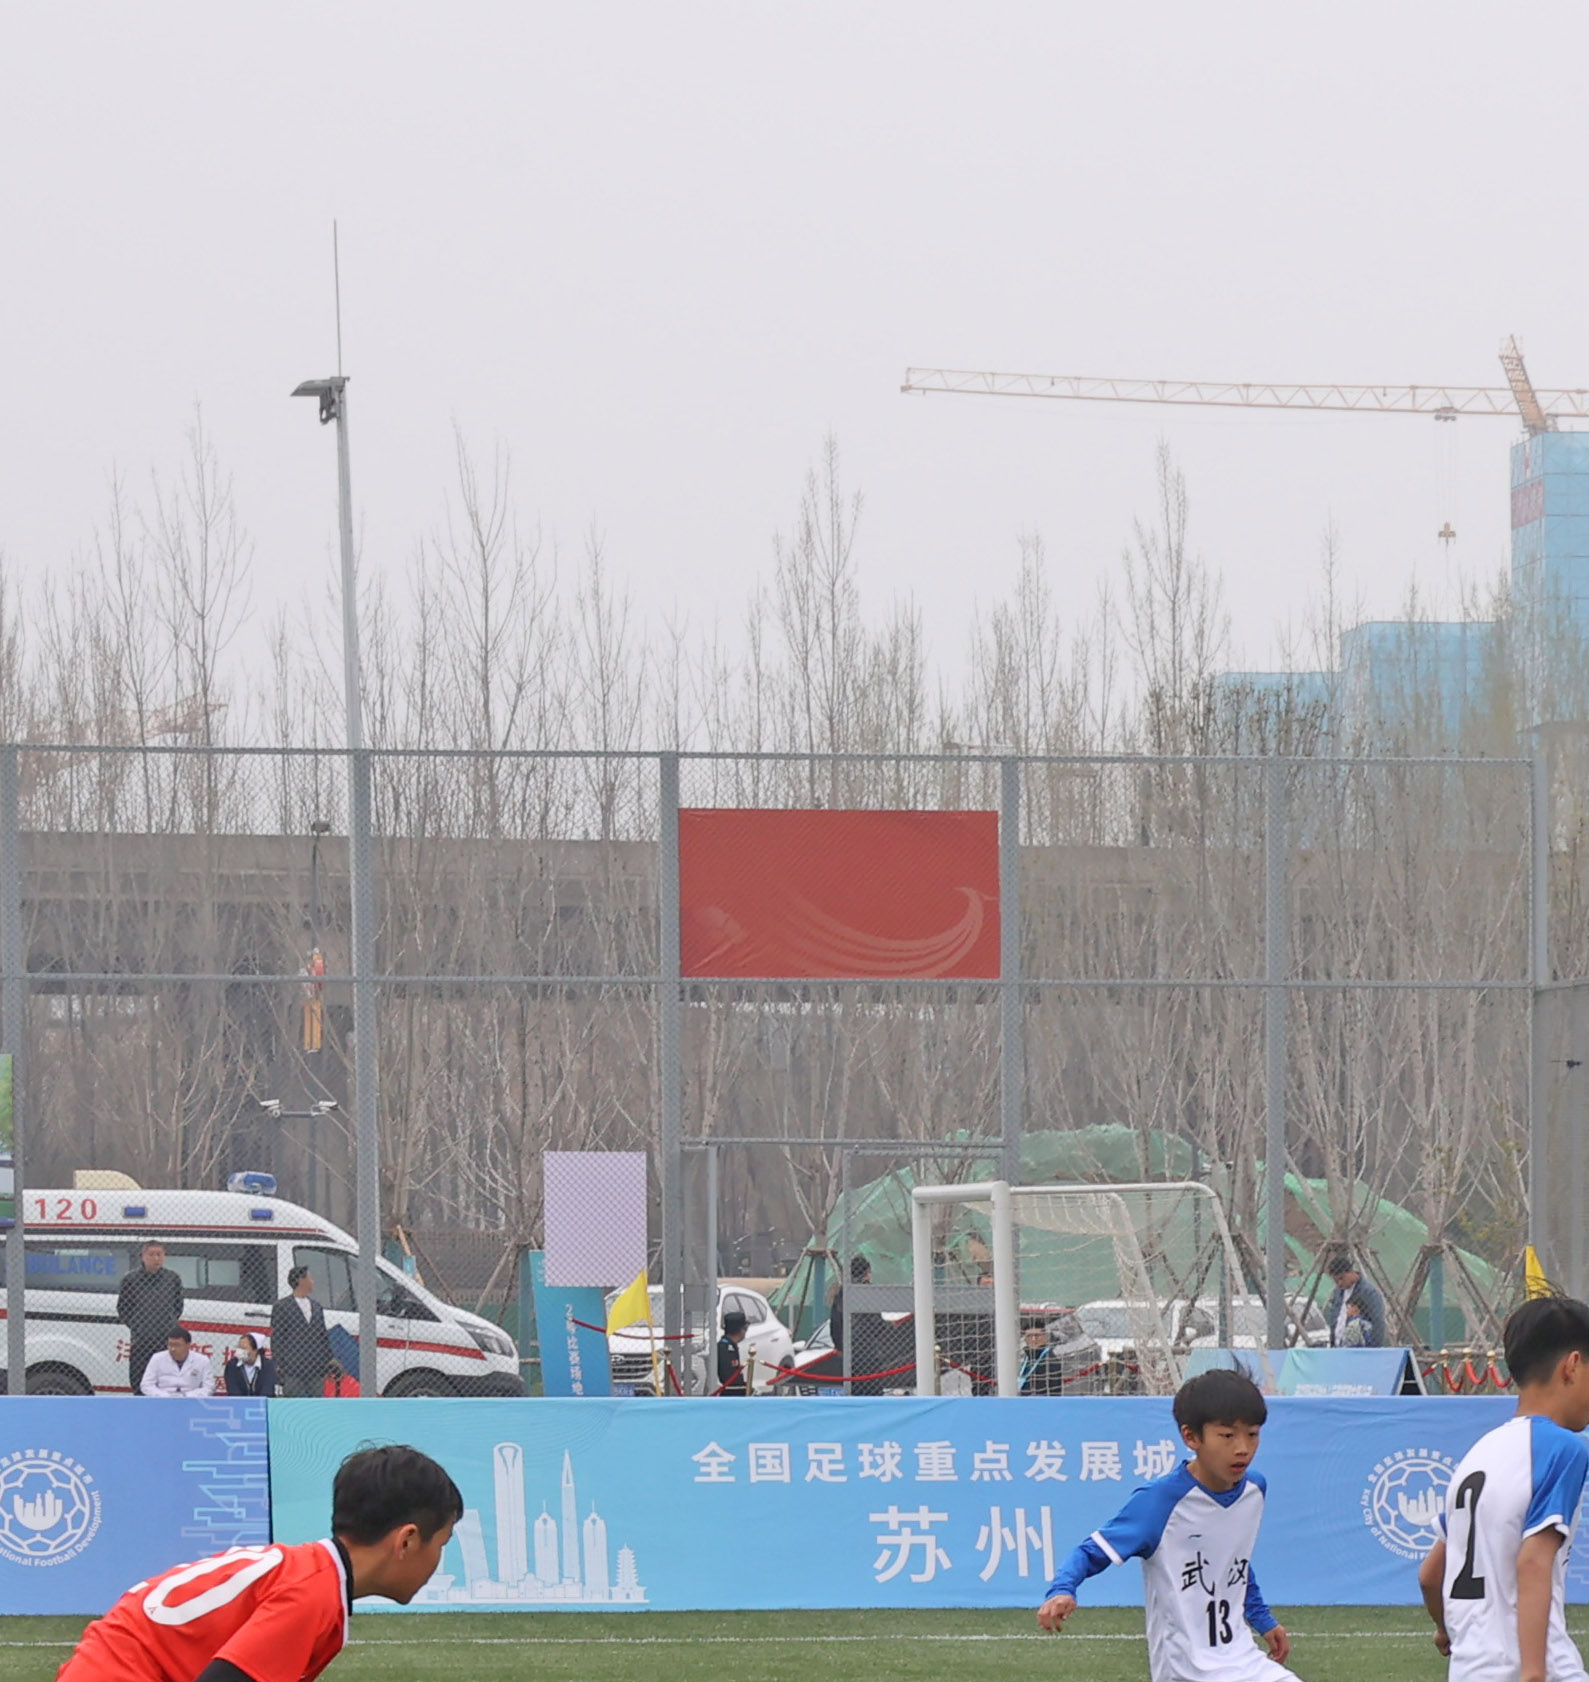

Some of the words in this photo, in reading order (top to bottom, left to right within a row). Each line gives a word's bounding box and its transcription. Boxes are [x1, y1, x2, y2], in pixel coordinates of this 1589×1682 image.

[35, 1198, 97, 1220] 120
[3, 1253, 117, 1276] BULANCE
[691, 1439, 1197, 1484] 全国足球重点发展城
[34, 1547, 77, 1567] Football
[74, 1490, 102, 1552] Development
[869, 1505, 1055, 1583] 苏州
[1377, 1536, 1418, 1560] National
[1449, 1470, 1486, 1600] 2
[1181, 1551, 1250, 1597] 武汉
[1206, 1599, 1233, 1647] 13
